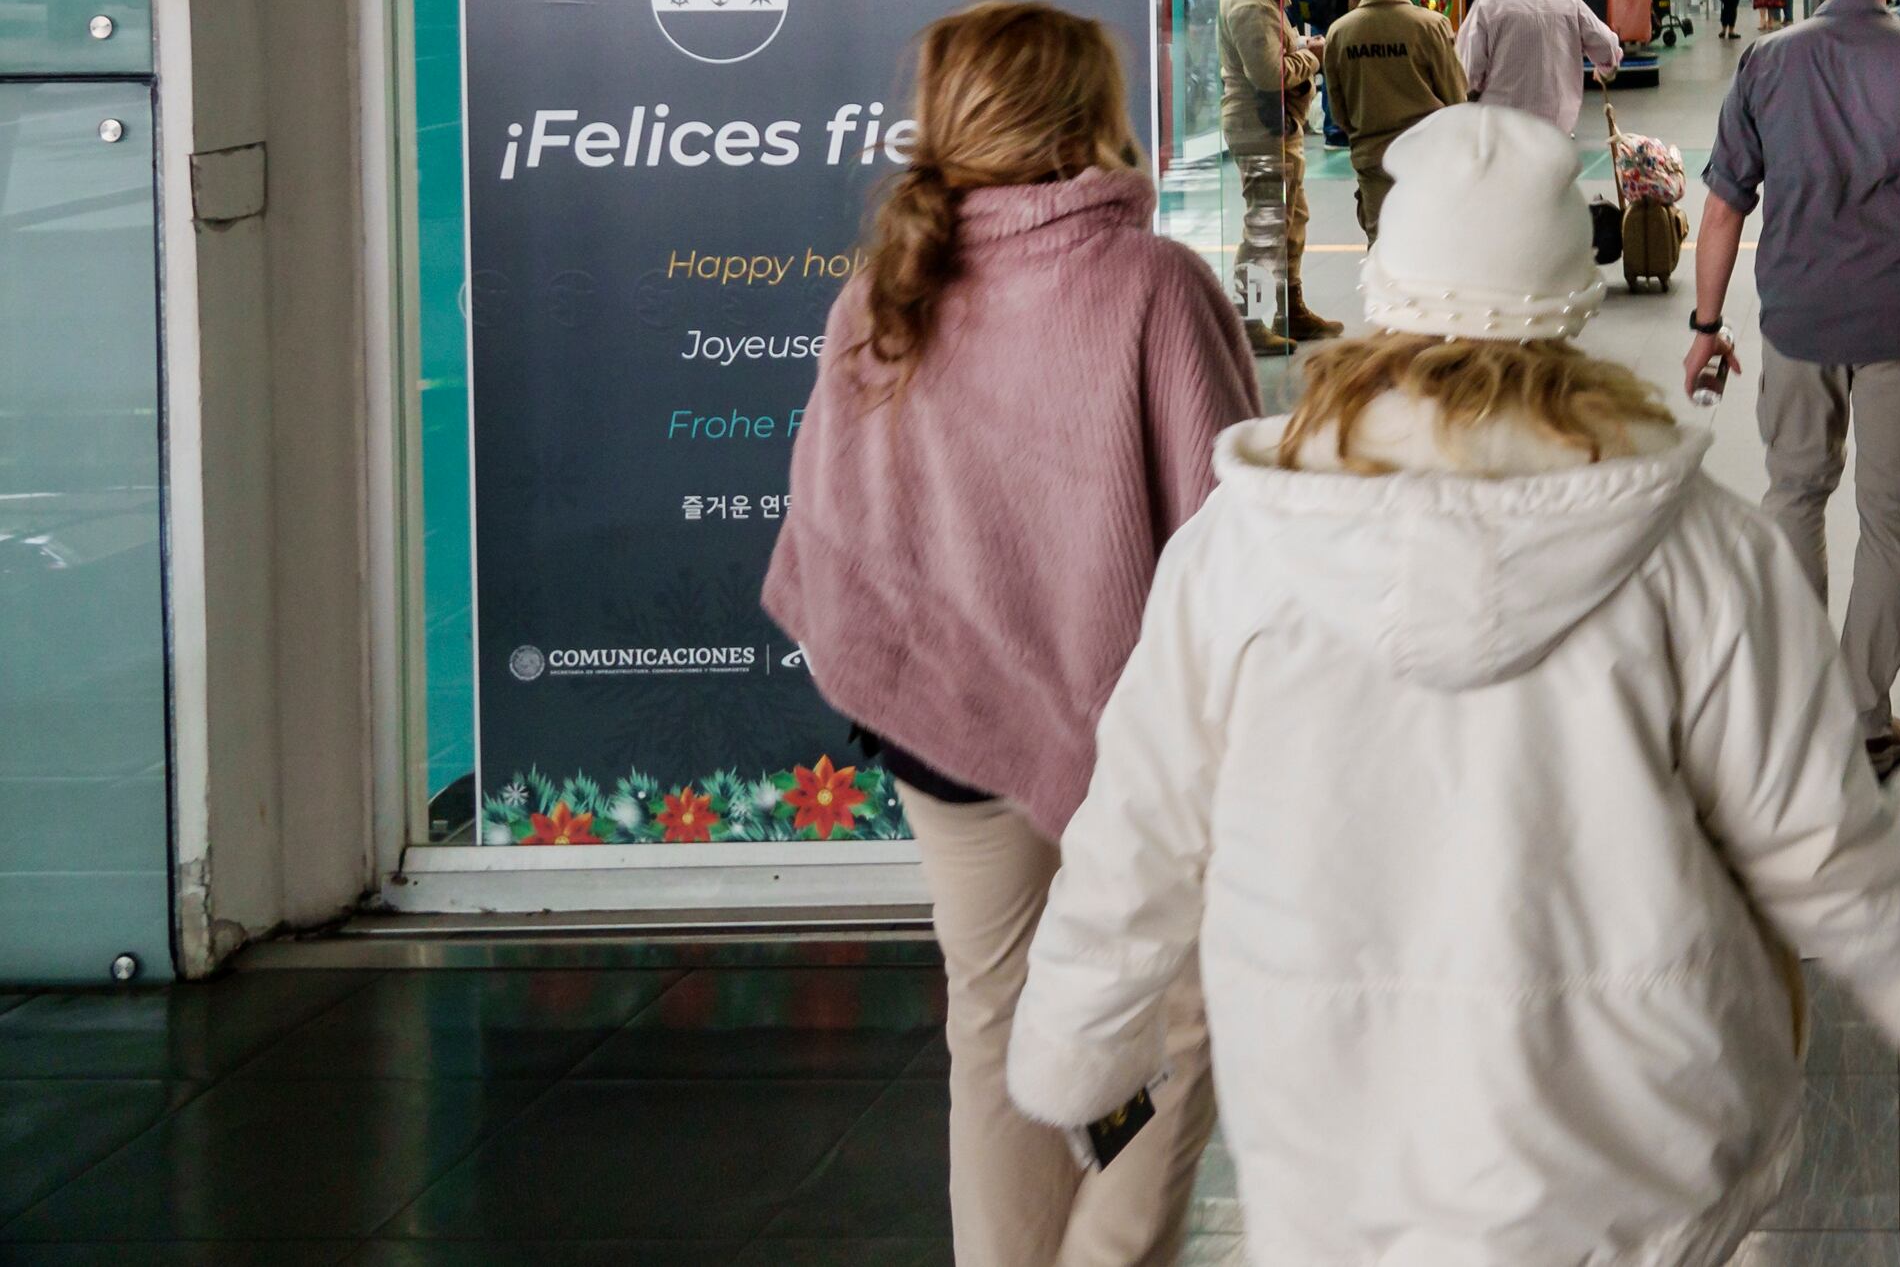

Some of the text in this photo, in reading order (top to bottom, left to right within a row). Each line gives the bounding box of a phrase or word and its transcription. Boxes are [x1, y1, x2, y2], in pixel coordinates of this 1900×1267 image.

[1346, 42, 1409, 61] MARINA
[500, 102, 802, 180] ¡Felices
[667, 249, 795, 285] Happy
[667, 408, 776, 439] Frohe
[681, 493, 752, 521] 즐거운
[549, 646, 756, 667] COMUNICACIONES
